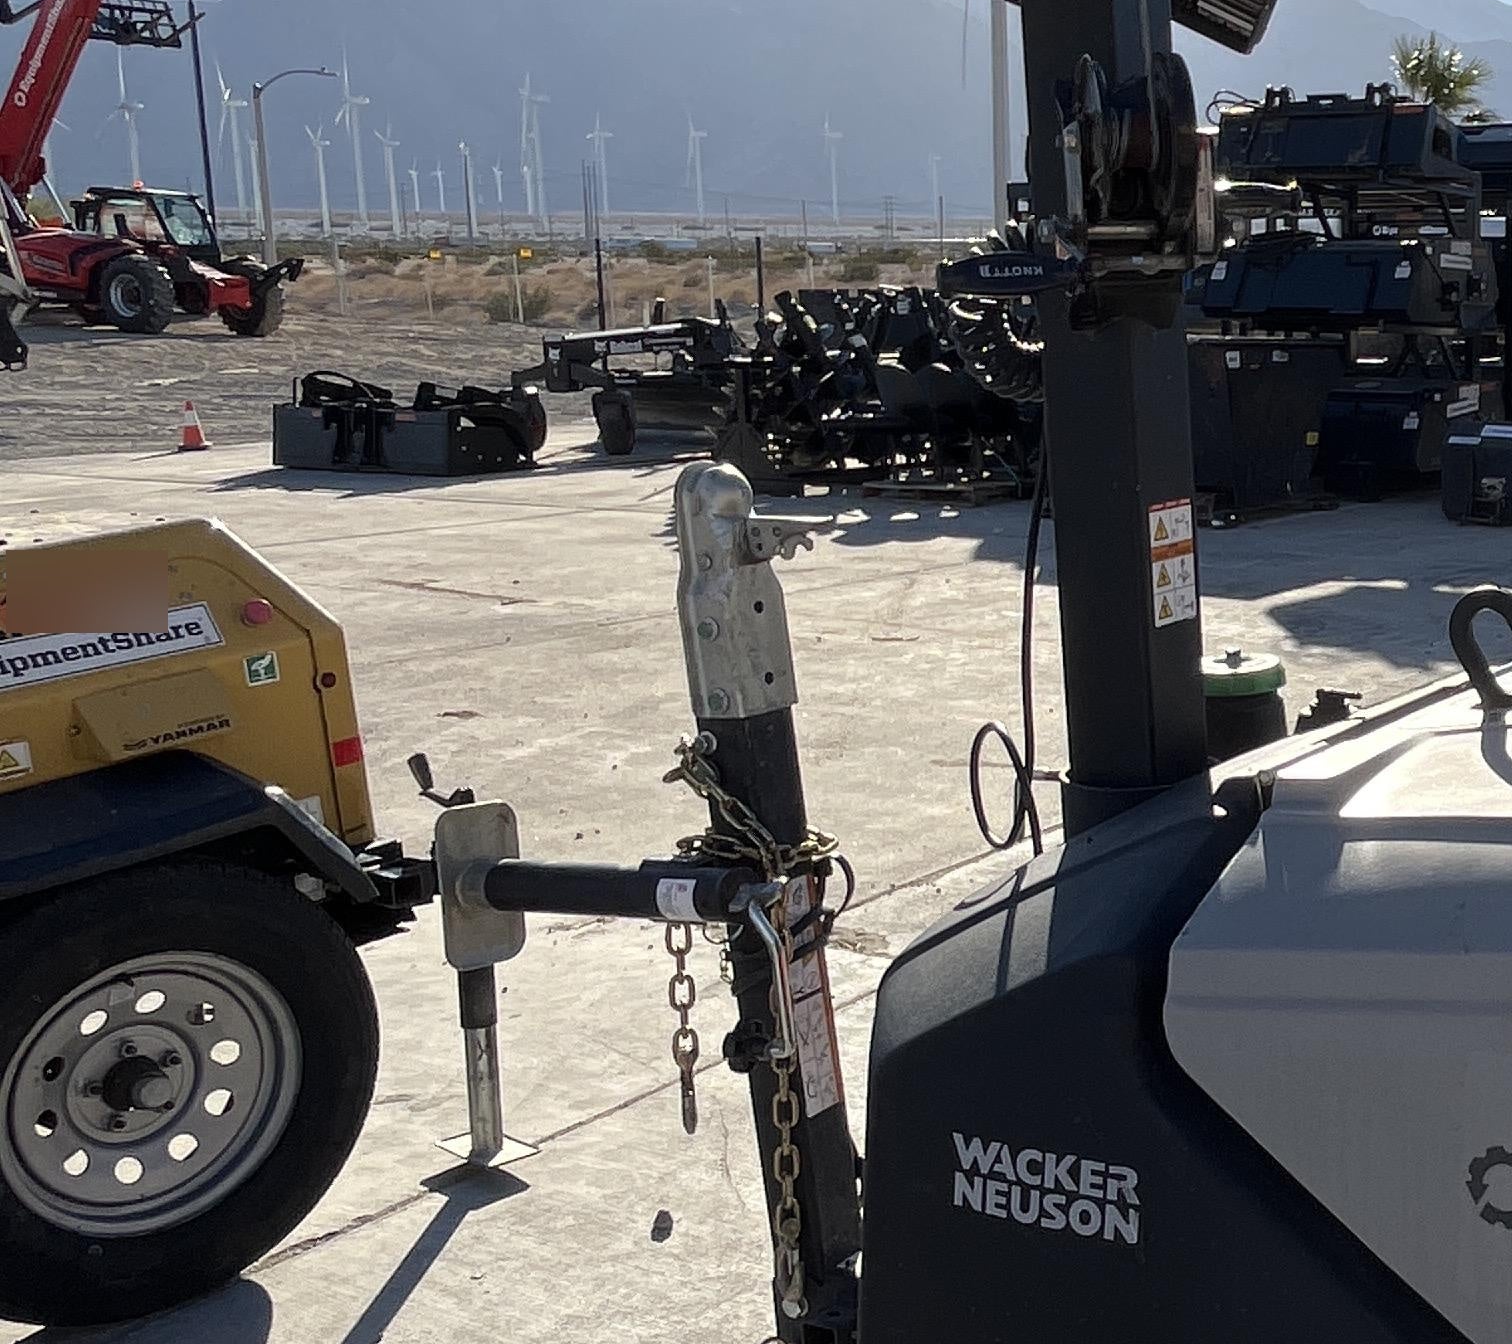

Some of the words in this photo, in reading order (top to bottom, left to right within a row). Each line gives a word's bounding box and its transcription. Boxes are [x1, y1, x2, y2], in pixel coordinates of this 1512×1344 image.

[150, 718, 231, 744] YANMAR
[952, 1131, 1141, 1206] WACKER
[953, 1170, 1141, 1245] NEUSON
